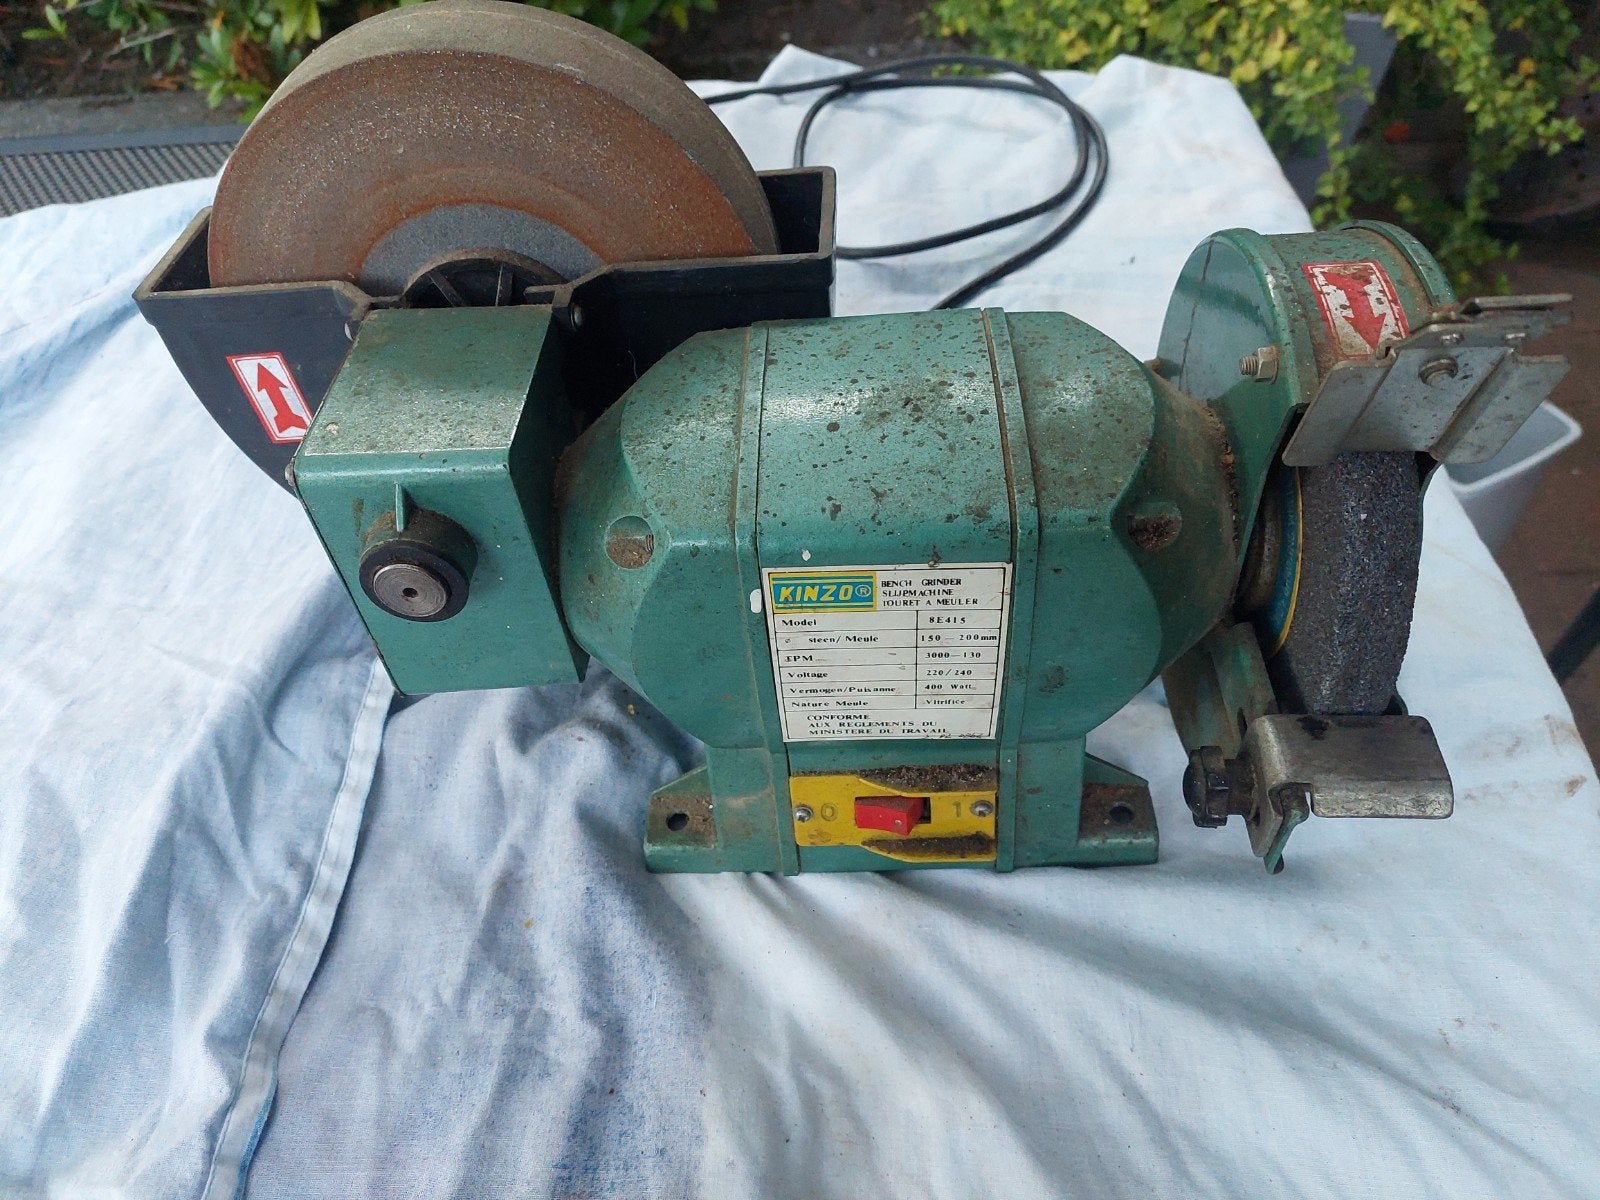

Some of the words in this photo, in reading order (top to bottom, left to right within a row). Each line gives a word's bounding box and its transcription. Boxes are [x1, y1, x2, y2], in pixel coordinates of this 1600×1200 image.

[881, 580, 912, 588] BENCH
[921, 578, 962, 587] GRINDER
[883, 599, 921, 607] TOURET
[937, 598, 979, 606] MEULER
[782, 619, 817, 627] Model
[929, 616, 967, 624] 8E415
[845, 635, 879, 643] Meule
[921, 634, 941, 642] 150
[788, 671, 829, 679] Voltage
[836, 699, 869, 707] Meule
